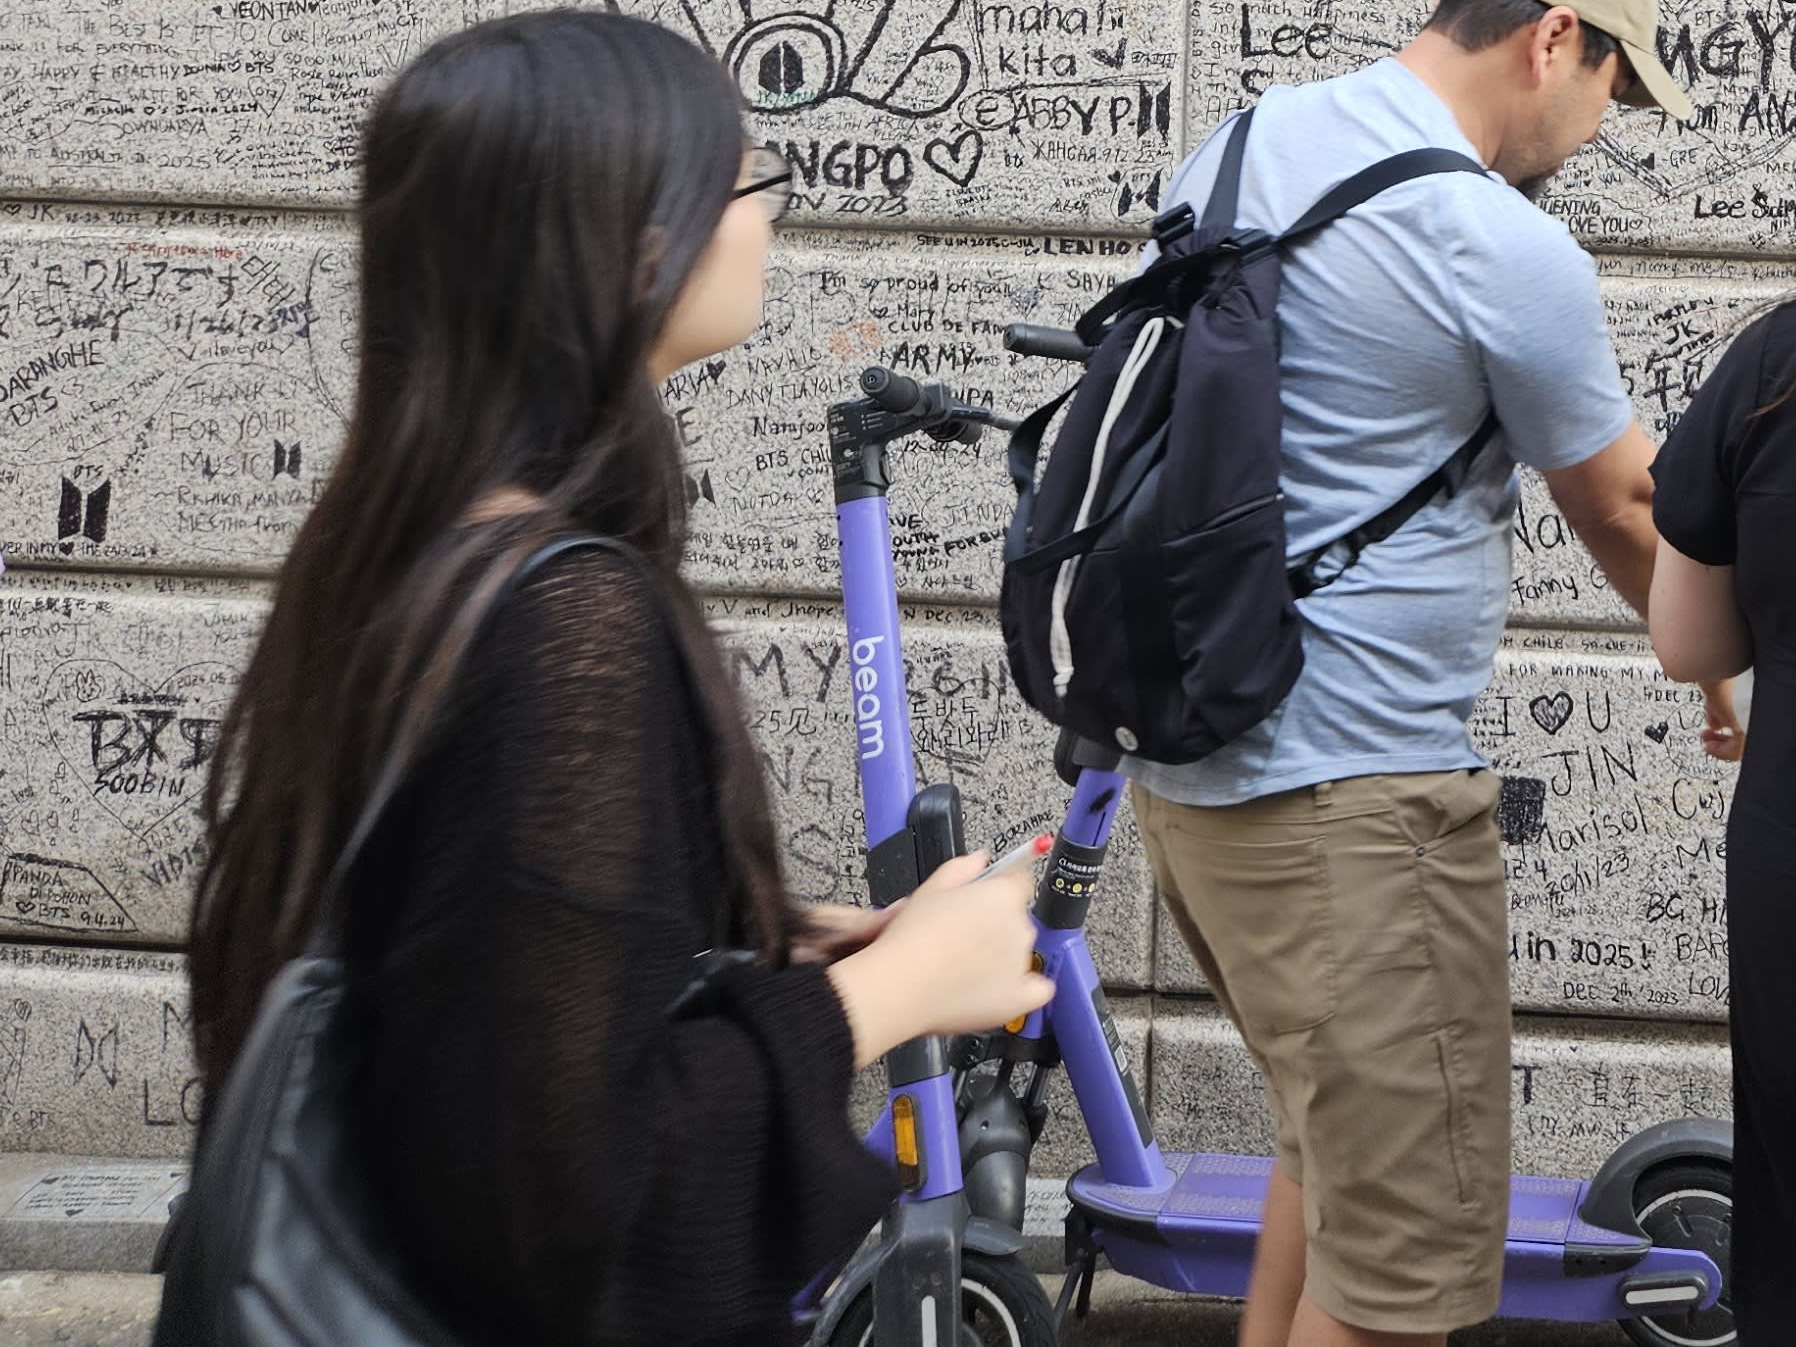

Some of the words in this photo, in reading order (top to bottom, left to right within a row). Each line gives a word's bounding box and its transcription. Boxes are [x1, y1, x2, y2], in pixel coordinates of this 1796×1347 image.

[228, 0, 308, 20] YEONTAN
[1238, 4, 1334, 61] Lee
[998, 43, 1078, 78] kita
[1693, 193, 1747, 219] Lee
[889, 342, 978, 375] ARMY
[10, 388, 58, 427] BTS
[1511, 576, 1580, 606] Fanny
[850, 635, 885, 760] beam
[1585, 689, 1613, 734] U
[93, 768, 187, 801] SOOBIN
[1542, 741, 1638, 797] JIN
